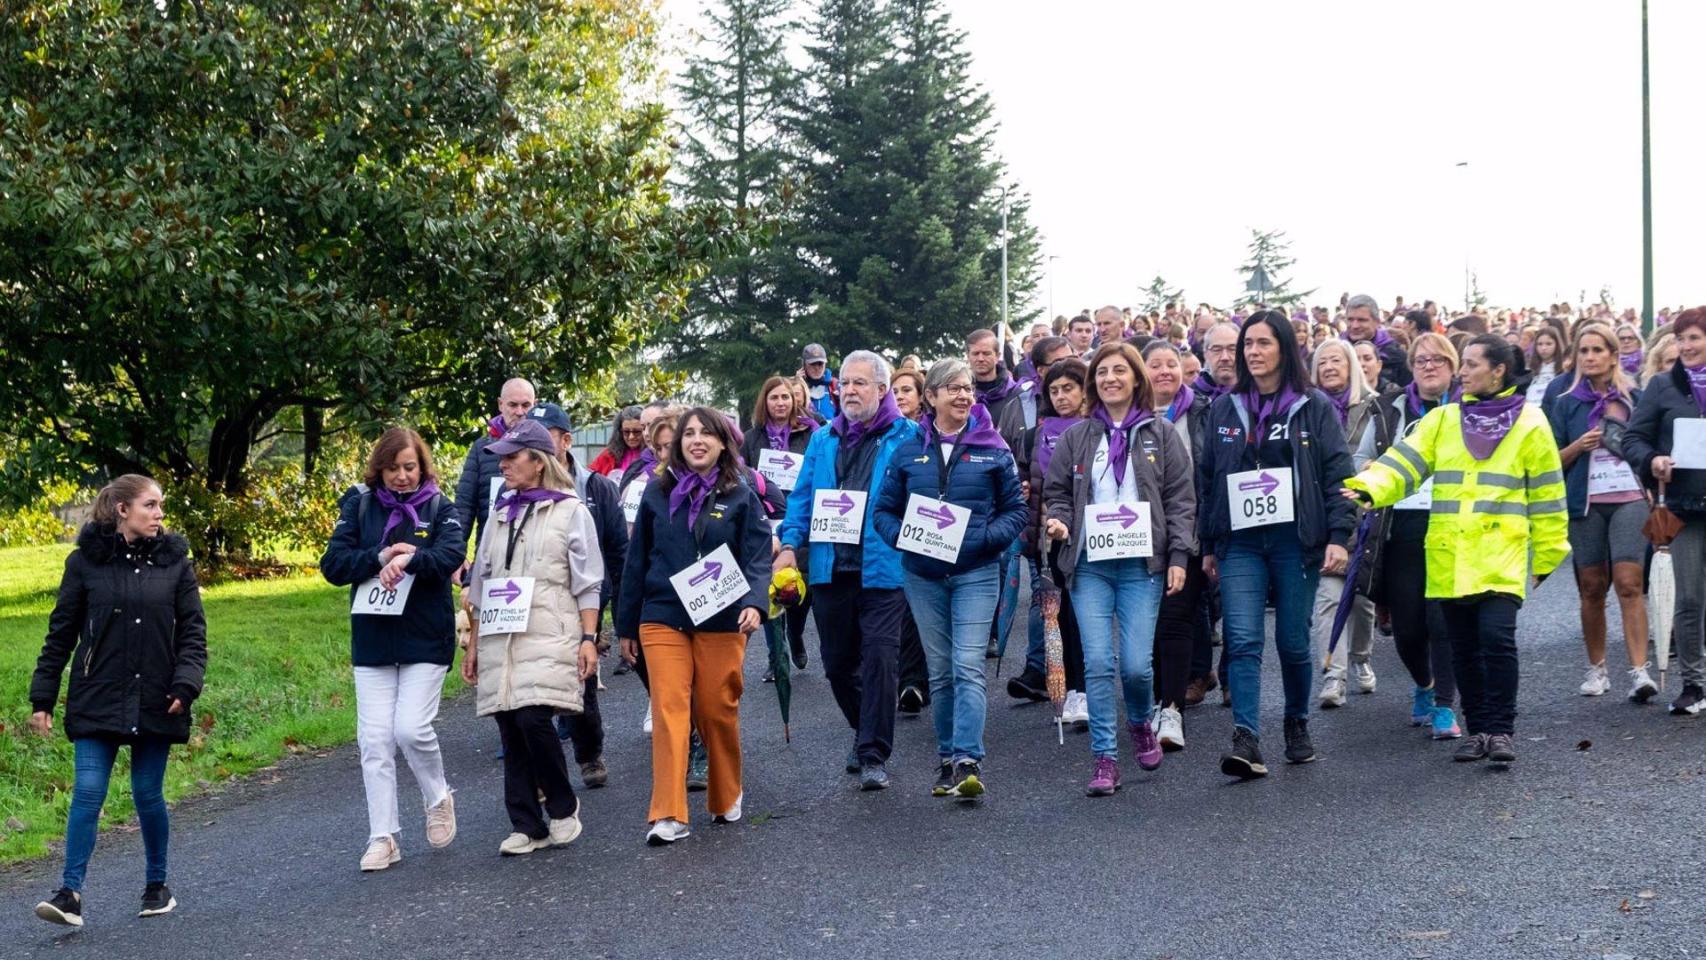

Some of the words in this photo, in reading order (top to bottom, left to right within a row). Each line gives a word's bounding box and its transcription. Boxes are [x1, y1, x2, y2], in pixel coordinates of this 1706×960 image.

[1268, 423, 1289, 441] 21
[1243, 495, 1277, 518] 058
[812, 518, 828, 532] 013
[902, 523, 924, 542] 012
[926, 531, 943, 541] ROSA
[1089, 533, 1114, 550] 006
[924, 538, 957, 552] QUINTANA
[368, 586, 398, 606] 018
[714, 577, 745, 600] LORENZANA
[689, 594, 709, 611] 002
[481, 608, 499, 624] 007
